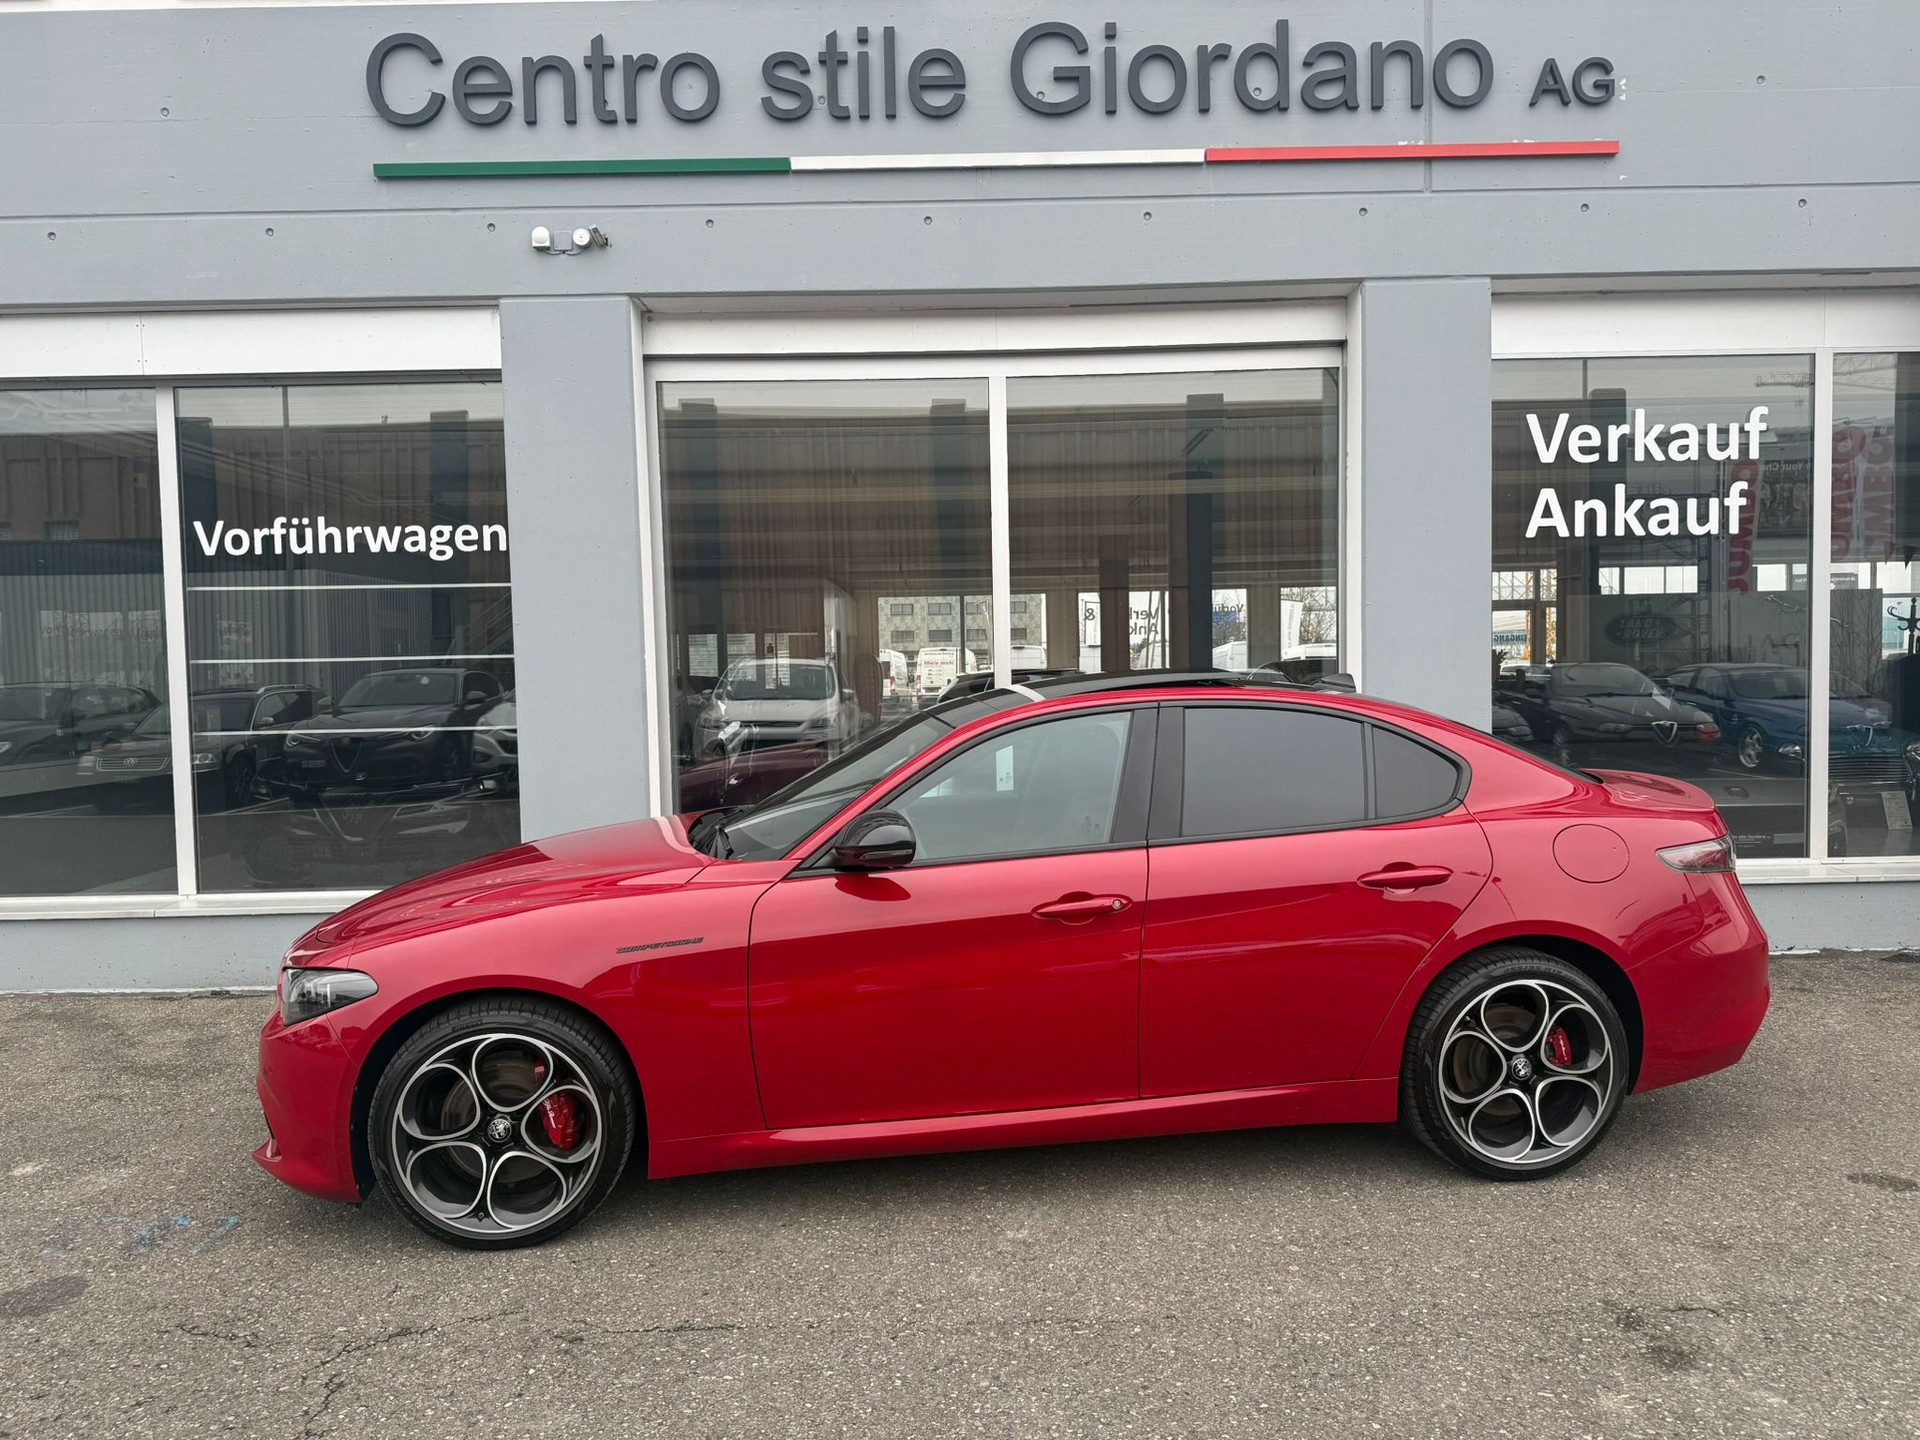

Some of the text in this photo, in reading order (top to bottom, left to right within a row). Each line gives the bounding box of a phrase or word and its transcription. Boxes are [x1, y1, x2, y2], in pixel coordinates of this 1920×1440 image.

[366, 19, 1616, 127] Centro stile Giordano AG
[1525, 405, 1769, 464] Verkauf
[193, 516, 507, 561] Vorführwagen
[1525, 481, 1748, 538] Ankauf
